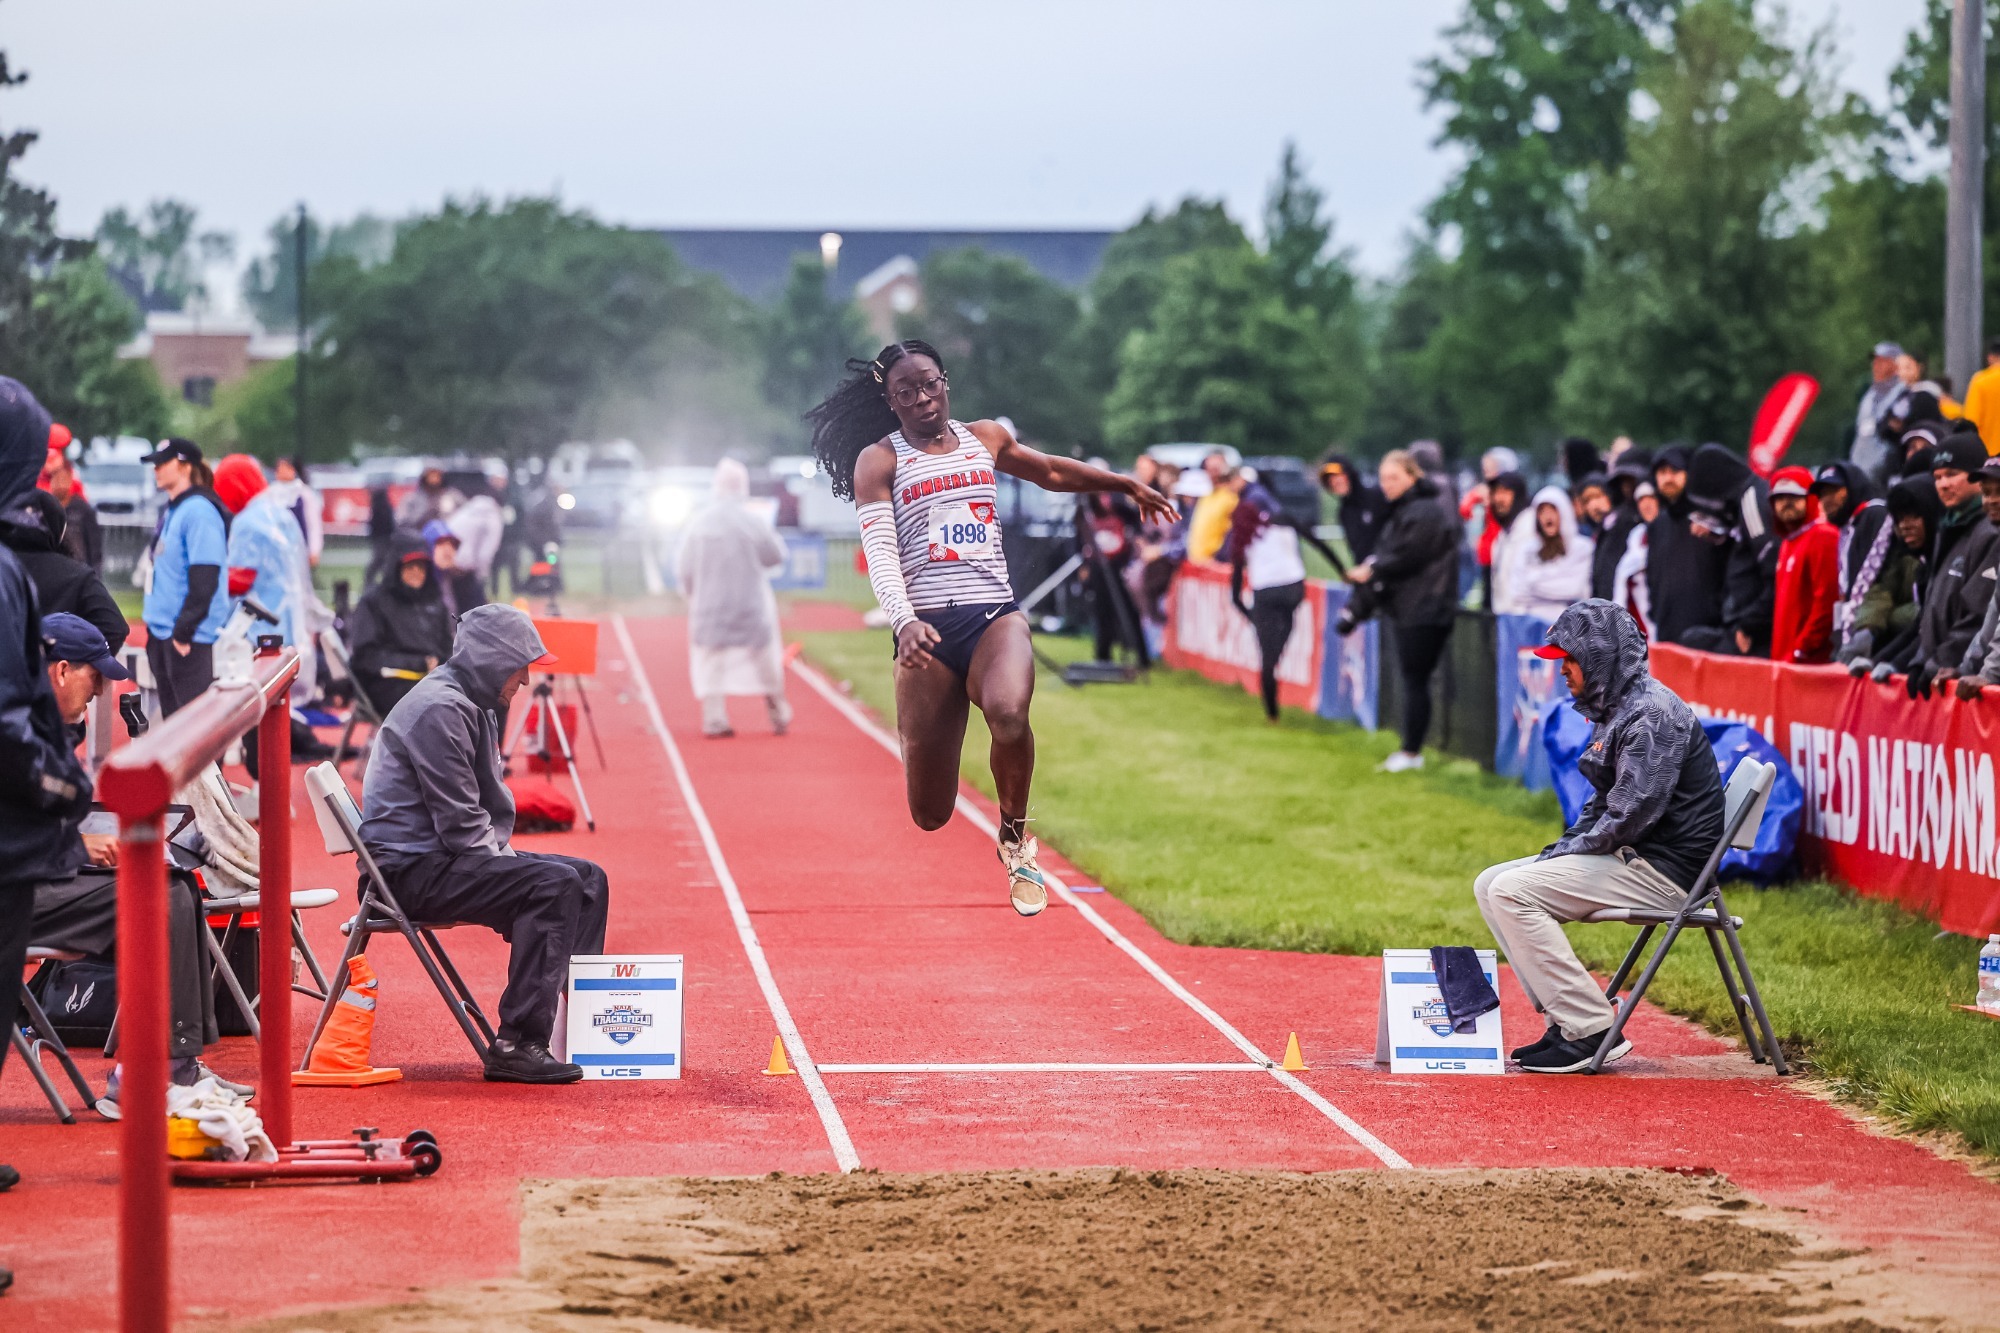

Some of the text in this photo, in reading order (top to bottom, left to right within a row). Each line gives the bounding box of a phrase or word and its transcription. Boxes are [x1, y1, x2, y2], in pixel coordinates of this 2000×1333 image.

[940, 523, 987, 545] 1898
[1790, 721, 1860, 845] FIELD
[611, 964, 641, 977] IWU
[1413, 1007, 1442, 1018] TRACK
[594, 1015, 622, 1025] TRACK
[627, 1015, 651, 1025] FIELD
